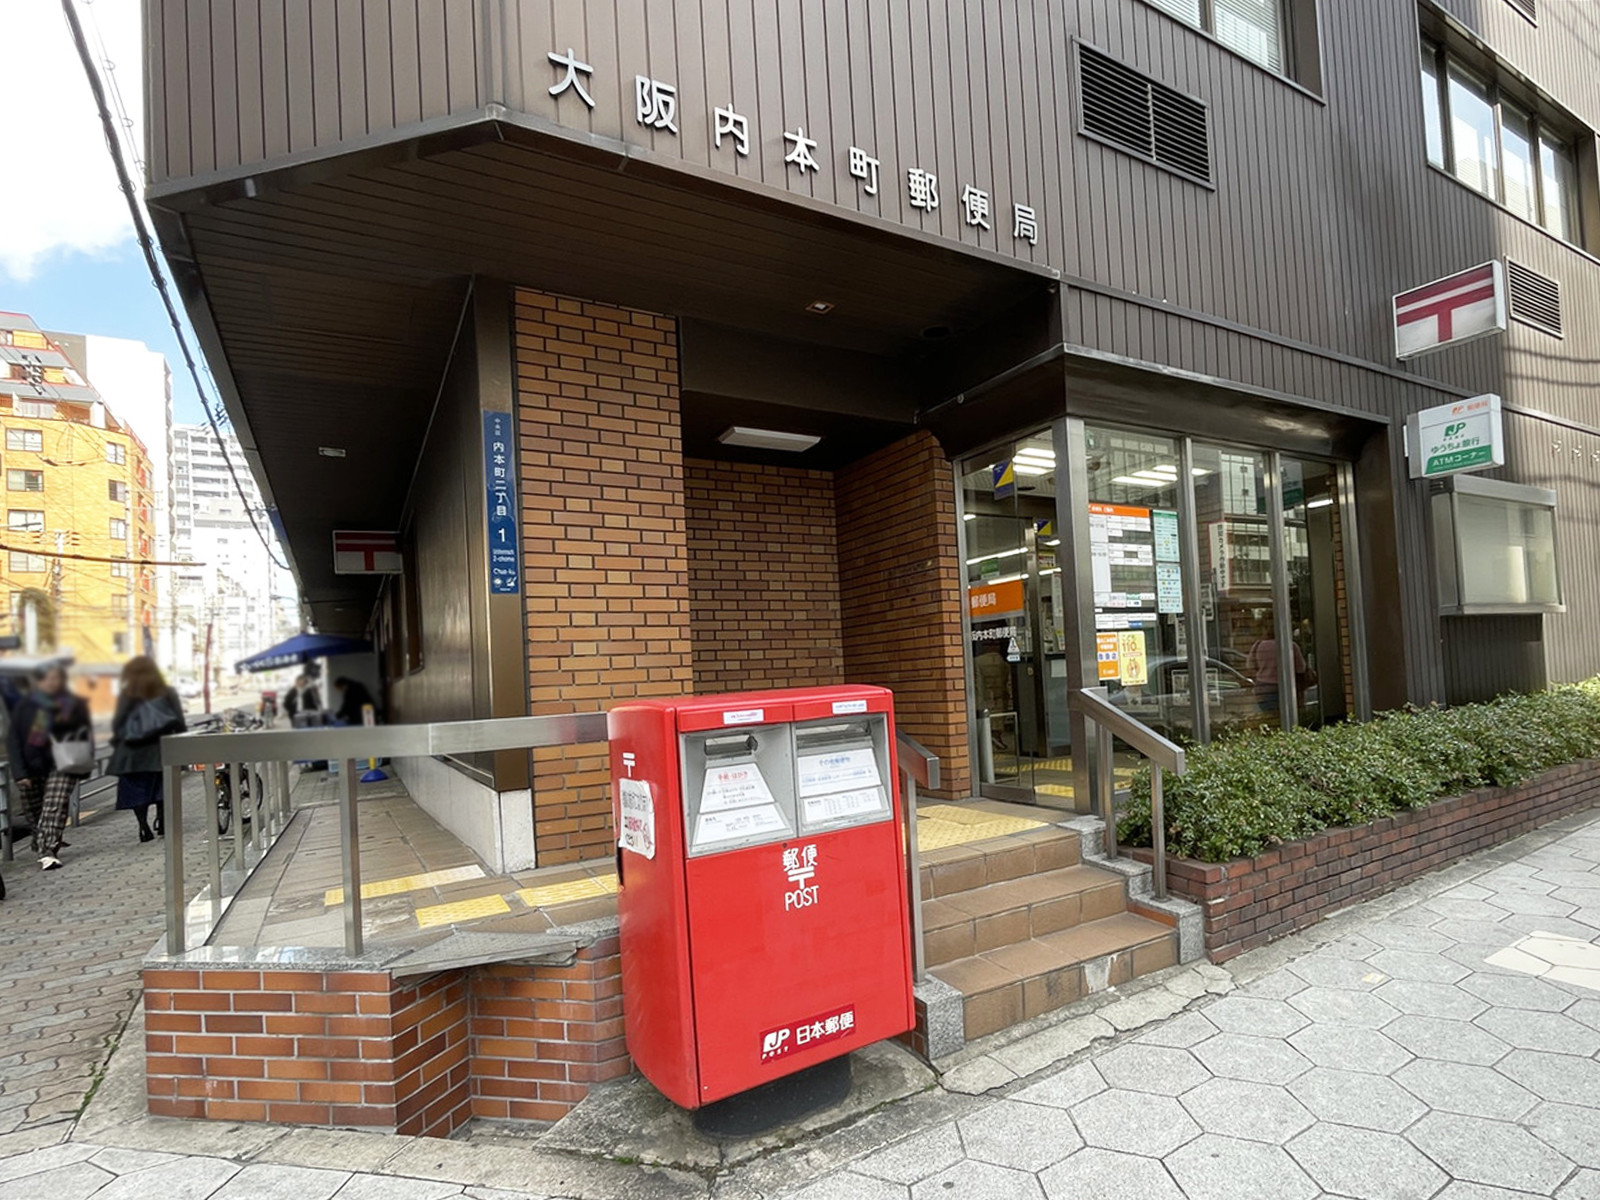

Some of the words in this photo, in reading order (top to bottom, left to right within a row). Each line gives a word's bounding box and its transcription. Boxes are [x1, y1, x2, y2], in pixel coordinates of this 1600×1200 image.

[547, 47, 1039, 246] 大阪内本町郵便局
[1431, 436, 1480, 454] ゆうちょ銀行
[1433, 451, 1486, 466] ATMコーナー
[493, 441, 507, 516] 内本町二丁目
[498, 528, 506, 543] 1
[783, 844, 818, 871] 郵便
[784, 885, 819, 911] POST
[796, 1011, 853, 1045] 日本郵便
